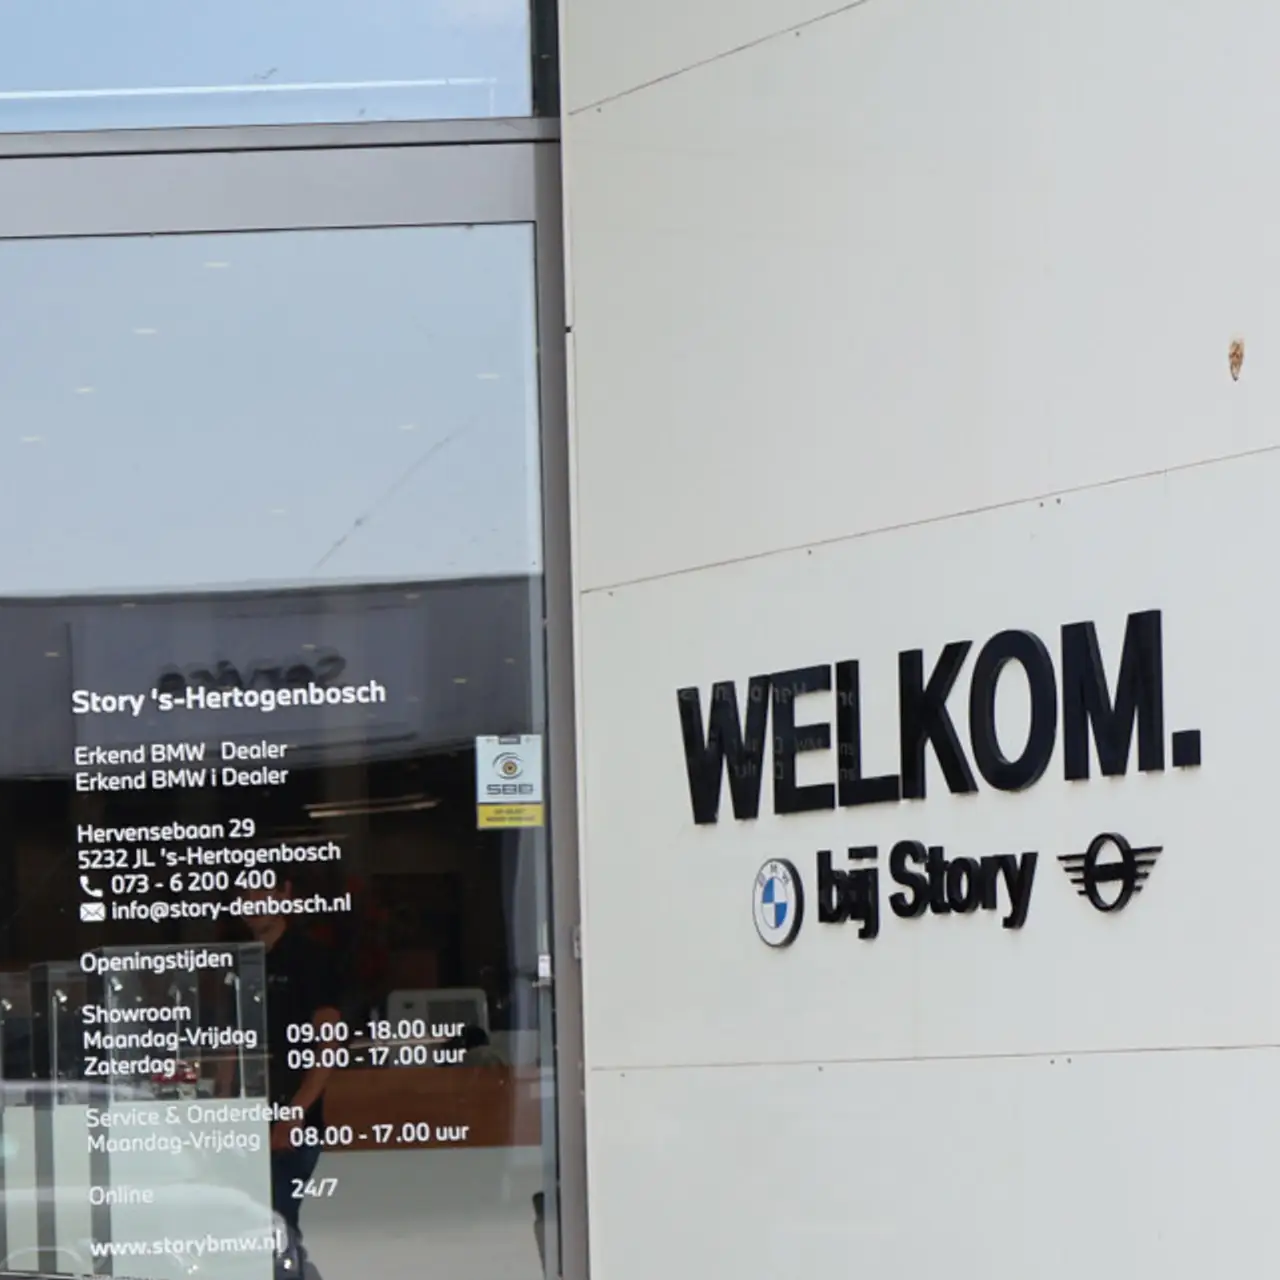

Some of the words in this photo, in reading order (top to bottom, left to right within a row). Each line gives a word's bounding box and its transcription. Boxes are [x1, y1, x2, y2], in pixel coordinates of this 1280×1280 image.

[73, 691, 144, 716] Story
[677, 609, 1201, 824] WELKOM.
[75, 745, 144, 765] Erkend
[152, 743, 205, 762] BMW
[222, 740, 287, 759] Dealer
[76, 771, 145, 791] Erkend
[152, 769, 206, 788] BMW
[212, 768, 216, 786] i
[222, 767, 288, 785] Dealer
[78, 822, 223, 842] Hervensebaan
[229, 819, 255, 837] 29
[79, 849, 128, 869] 5232
[133, 849, 155, 868] JL
[112, 874, 148, 893] 073
[170, 873, 182, 891] 6
[189, 871, 228, 891] 200
[235, 870, 275, 889] 400
[817, 845, 878, 939] bij
[889, 839, 1038, 929] Story
[112, 893, 351, 922] info@story-denbosch.nl
[81, 950, 232, 974] Openingstijden
[82, 1005, 191, 1023] Showroom
[84, 1027, 256, 1051] Maandag-Vrijdag
[287, 1022, 348, 1042] 09.00
[368, 1020, 425, 1039] 18.00
[432, 1023, 464, 1037] uur
[85, 1056, 176, 1079] Zaterdag
[288, 1048, 349, 1068] 09.00
[433, 1049, 466, 1063] uur
[87, 1107, 159, 1128] Service
[166, 1106, 179, 1126] &
[188, 1103, 303, 1124] Onderdelen
[88, 1131, 260, 1155] Maandag-Vrijdag
[291, 1126, 352, 1146] 08.00
[436, 1126, 469, 1140] uur
[90, 1186, 153, 1206] Online
[292, 1178, 338, 1197] 24/7
[91, 1231, 282, 1256] www.storybmw.nl
